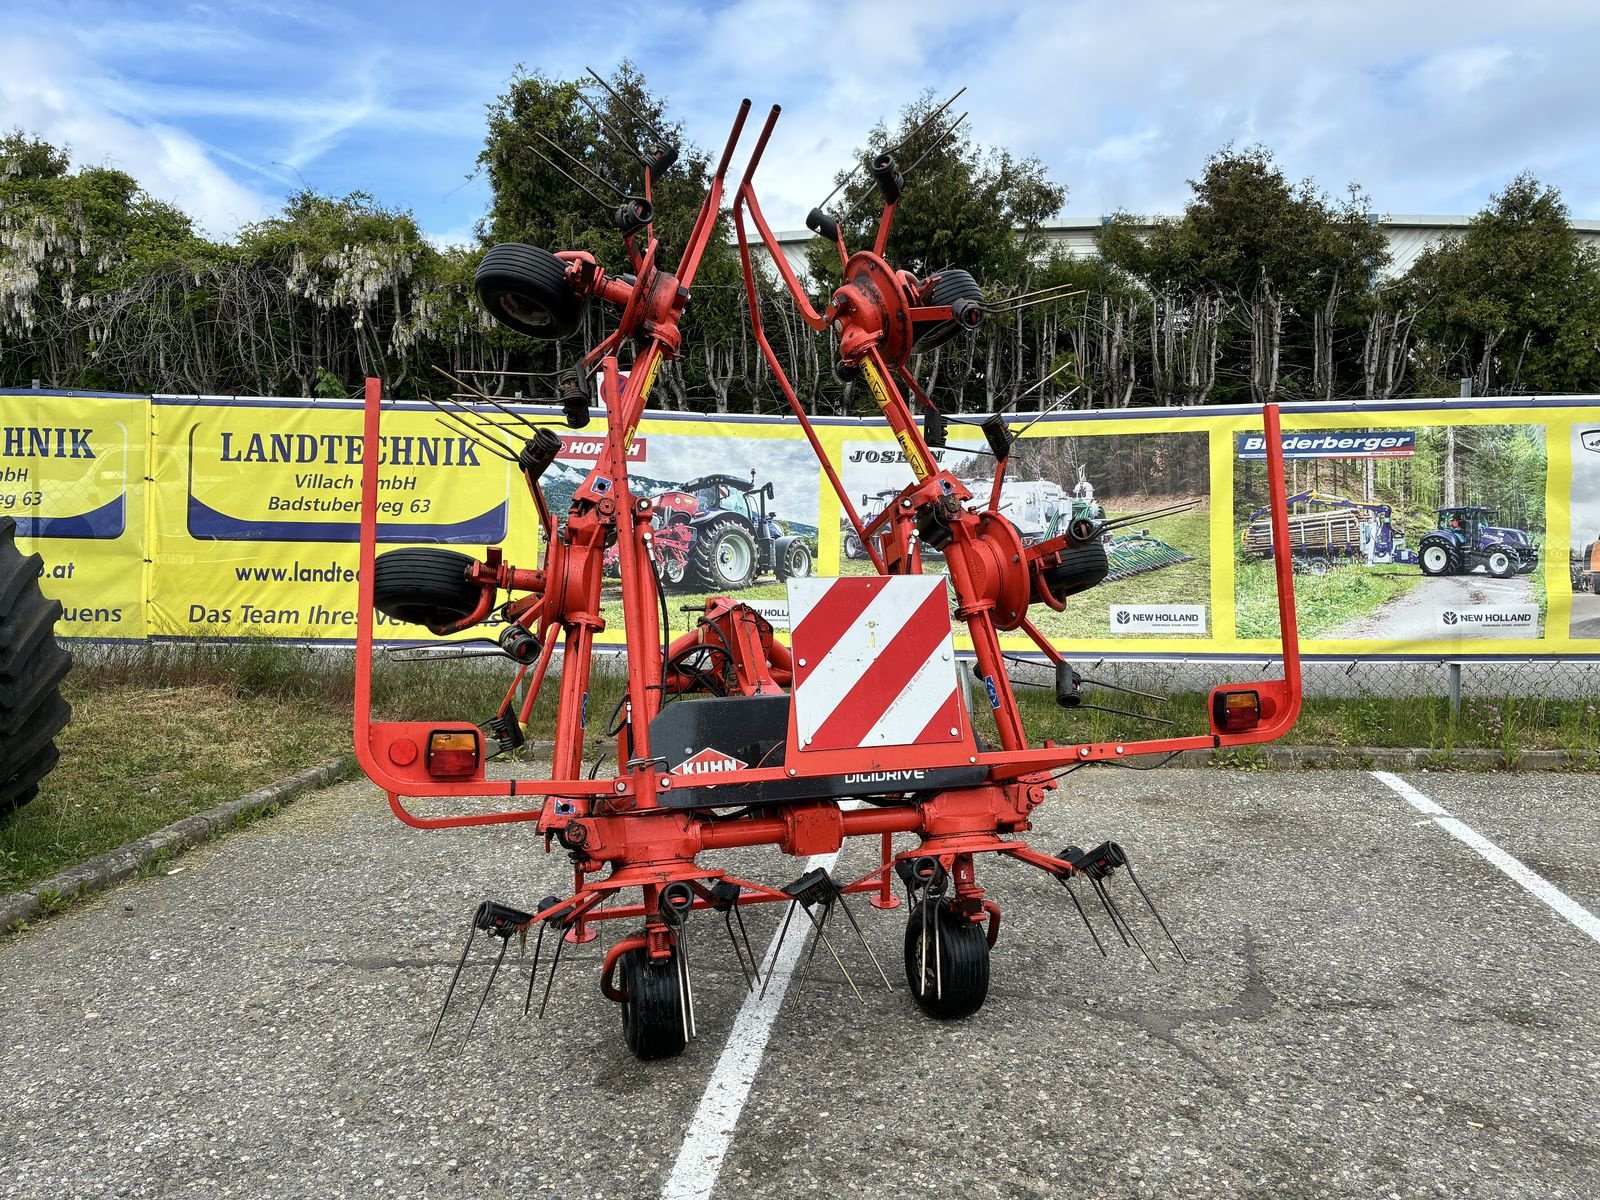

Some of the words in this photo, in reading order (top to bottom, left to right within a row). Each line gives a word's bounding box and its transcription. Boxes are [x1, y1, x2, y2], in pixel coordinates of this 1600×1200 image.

[569, 441, 640, 456] HORH
[1244, 436, 1410, 450] Biderberger
[849, 450, 946, 463] JOSKN
[0, 467, 28, 482] bH
[295, 474, 354, 490] Villach
[360, 475, 417, 490] mbH
[23, 492, 43, 505] 63
[410, 499, 431, 513] 63
[189, 604, 232, 624] Das
[241, 605, 299, 624] Team
[1132, 613, 1153, 622] NEW
[1155, 613, 1199, 622] HOLLAND
[1460, 613, 1483, 622] NEW
[1485, 613, 1531, 622] HOLLAND
[682, 759, 737, 775] KUHN
